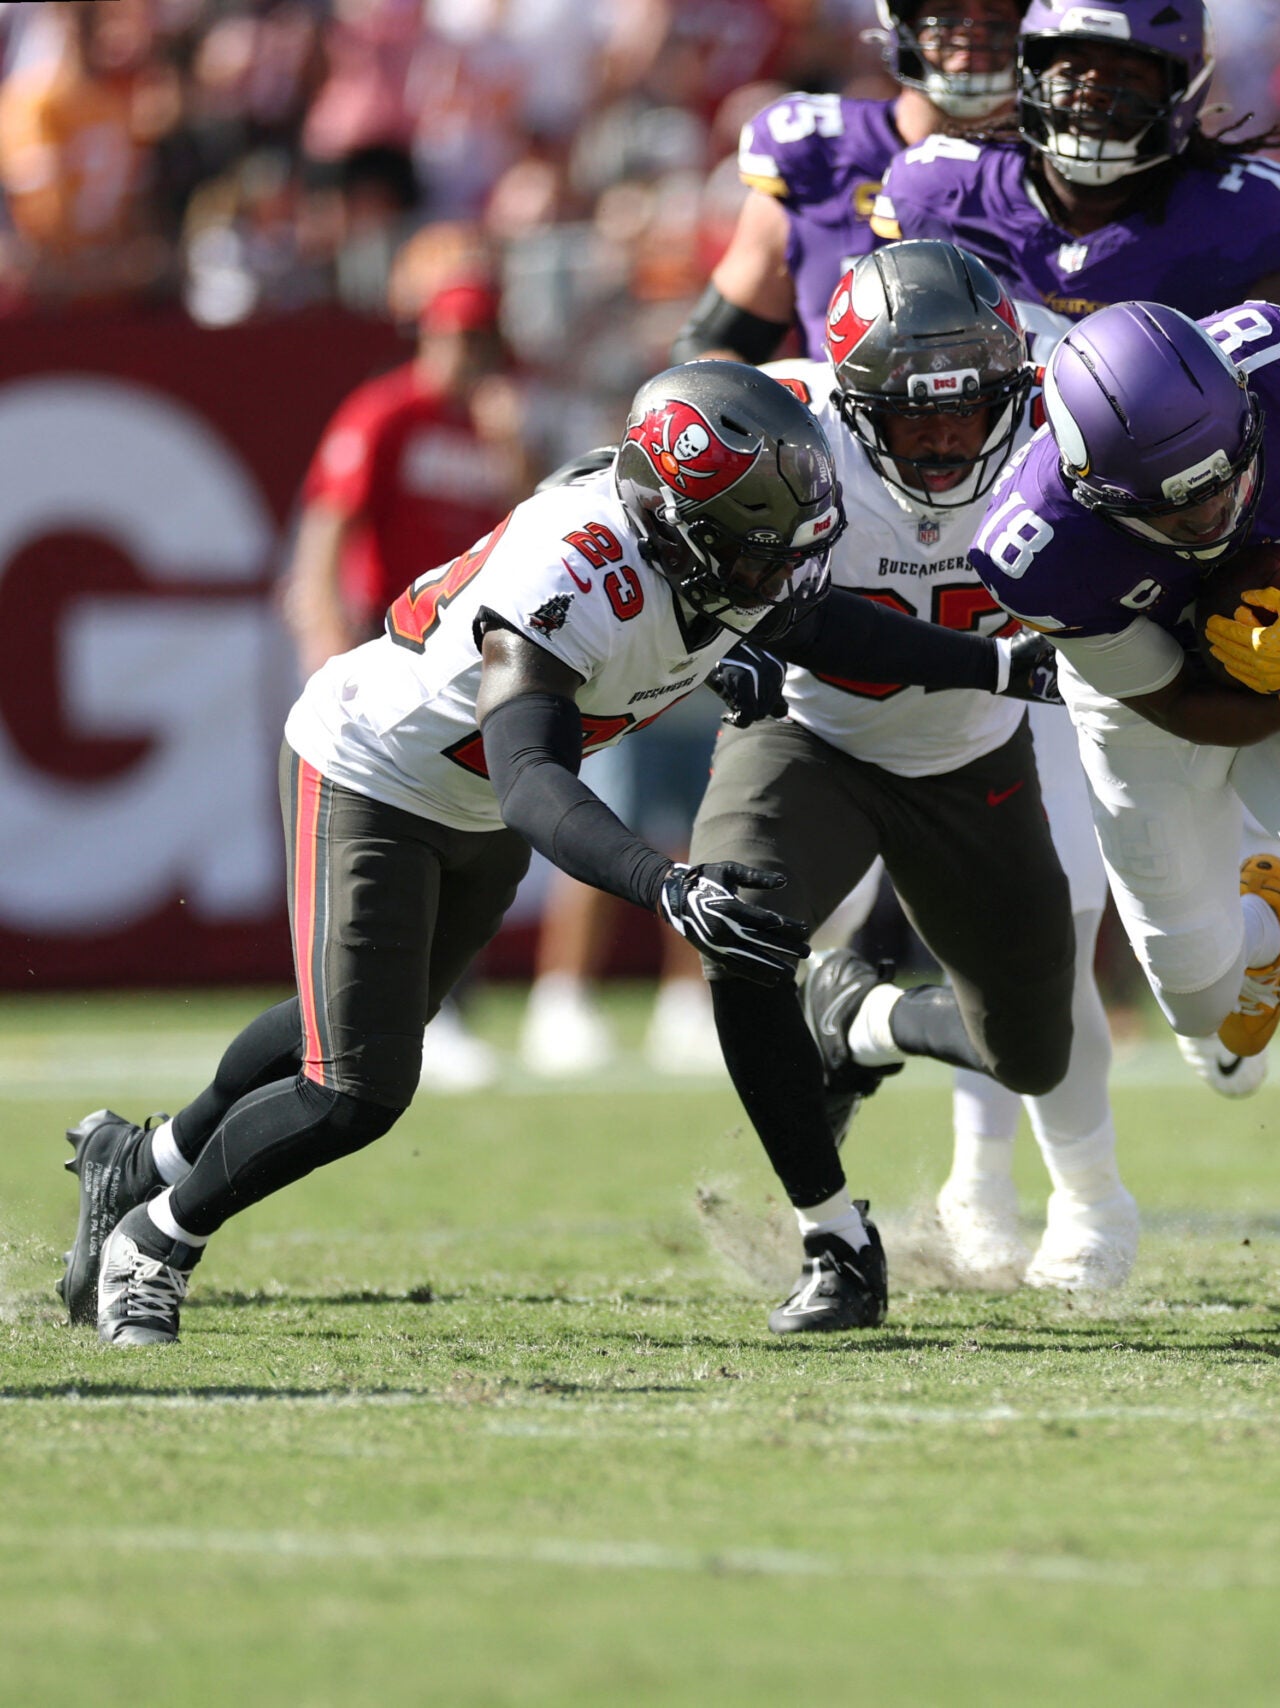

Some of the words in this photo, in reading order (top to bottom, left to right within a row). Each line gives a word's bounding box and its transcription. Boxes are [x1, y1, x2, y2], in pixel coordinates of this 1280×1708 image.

[561, 521, 645, 622] 23
[977, 491, 1055, 580] 18
[88, 1236, 98, 1257] USA
